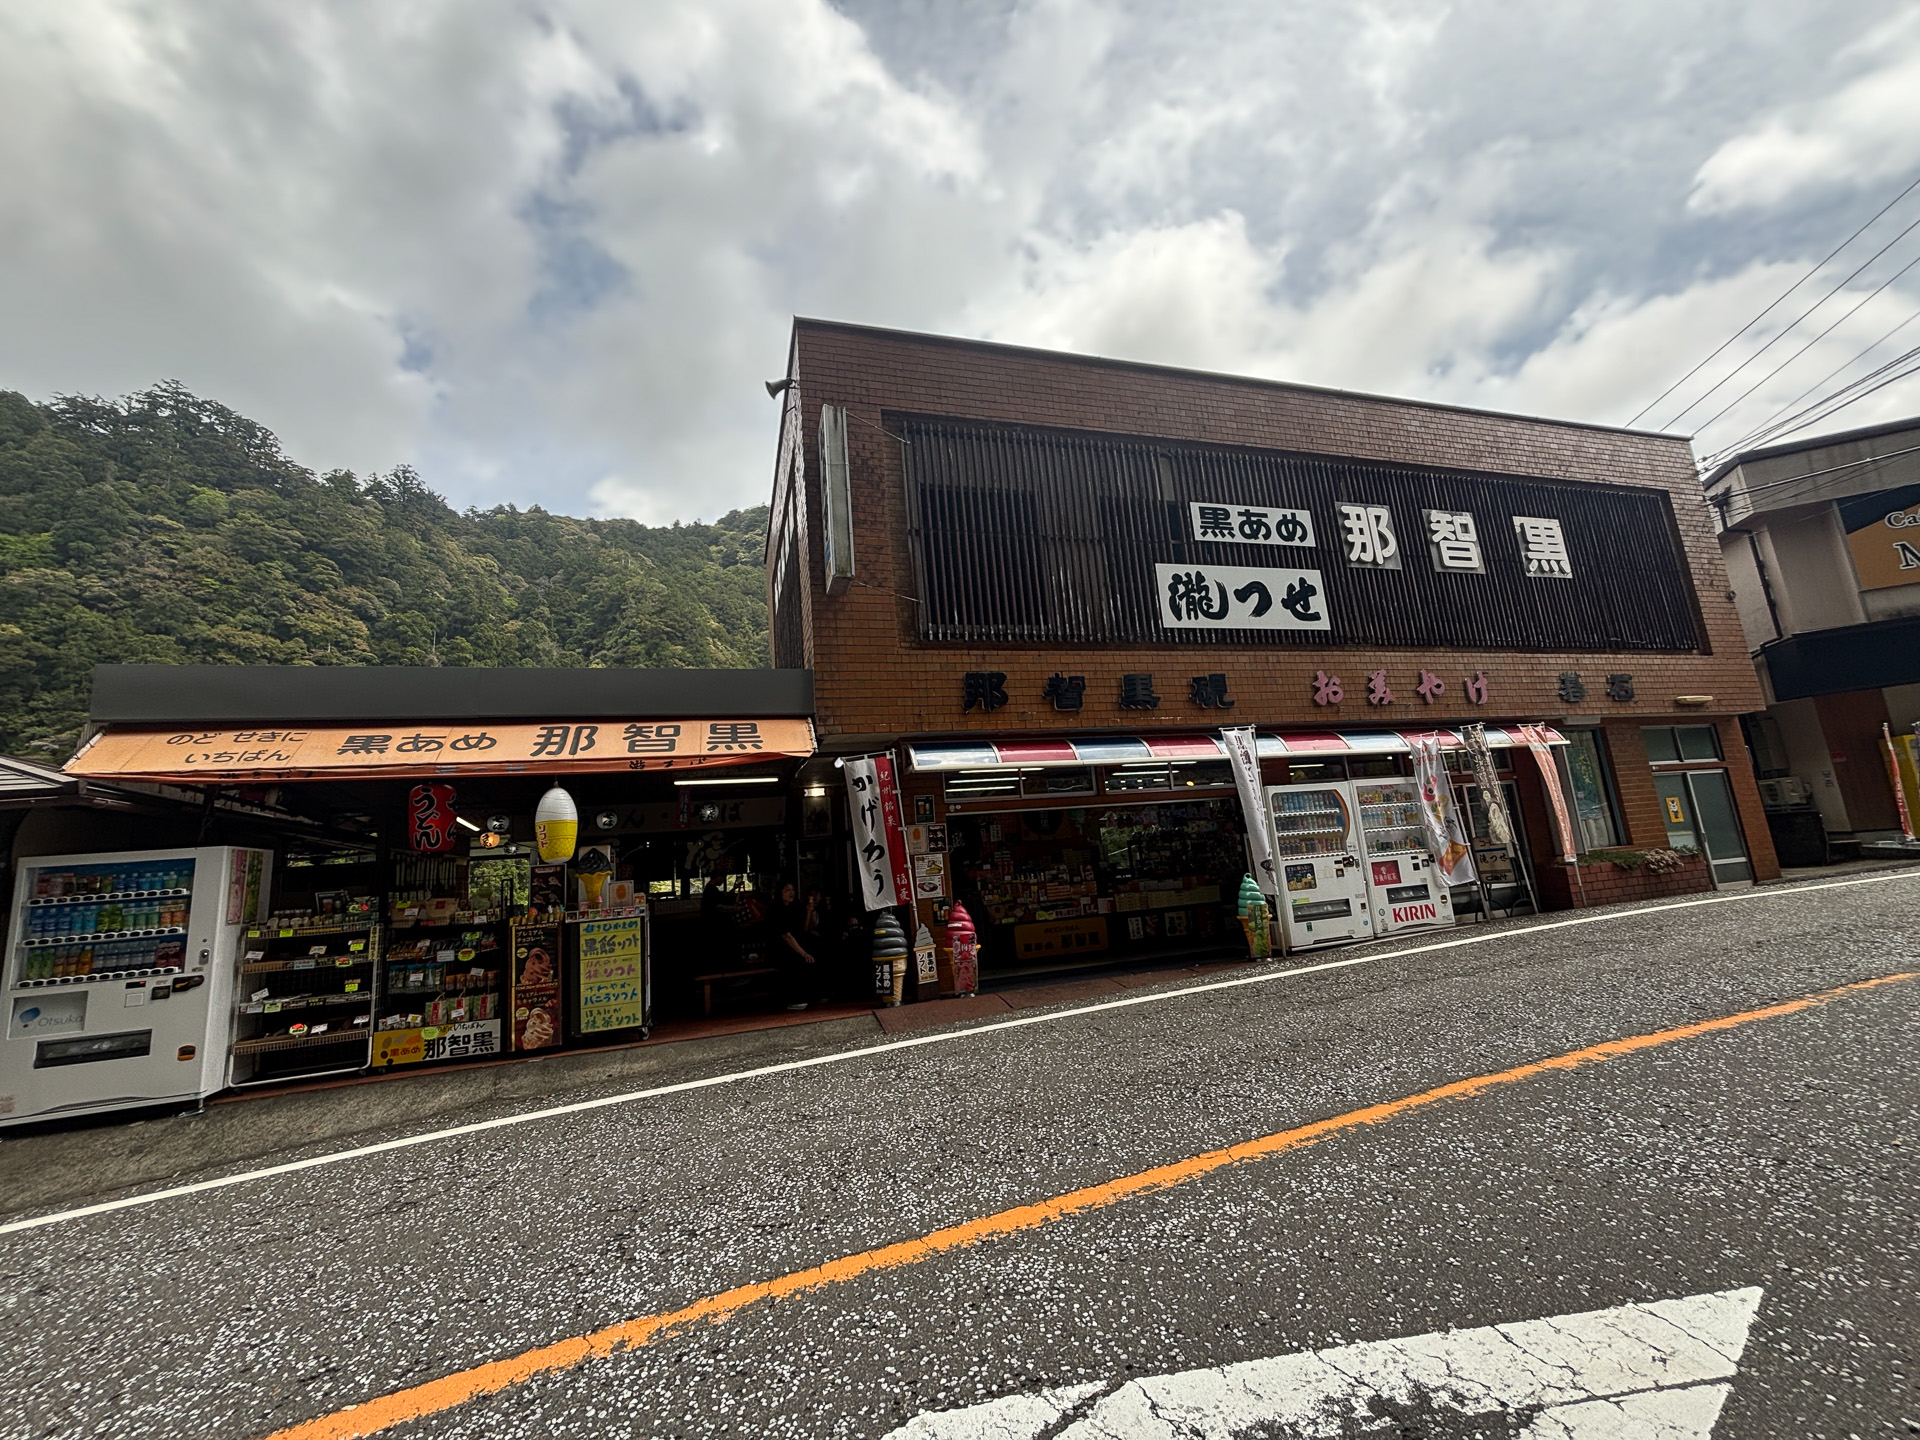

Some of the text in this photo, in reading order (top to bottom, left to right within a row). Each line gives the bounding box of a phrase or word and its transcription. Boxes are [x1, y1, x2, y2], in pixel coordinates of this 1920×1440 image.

[1197, 506, 1308, 544] 黒あめ
[1885, 508, 1920, 528] Ca
[1340, 505, 1571, 575] 那智黒
[962, 671, 1235, 713] 那智黒硯
[166, 731, 308, 746] のど せきに
[337, 722, 764, 758] 黒あめ 那智黒
[184, 749, 291, 764] いちばん
[413, 787, 442, 850] うどん
[538, 824, 549, 848] ソフト
[1392, 903, 1437, 923] KIRIN
[583, 921, 638, 933] 甘さひかえめ
[582, 934, 640, 956] 黒飴ソフト
[918, 953, 926, 975] ソフト
[926, 951, 935, 973] 黒あめ
[882, 964, 891, 987] 黒あめ
[584, 988, 638, 1006] バニラソフト
[38, 1014, 83, 1027] Otsuka
[585, 1013, 640, 1030] 抹茶ソフト
[389, 1045, 421, 1058] 黒あめ
[422, 1031, 494, 1060] 那智黒
